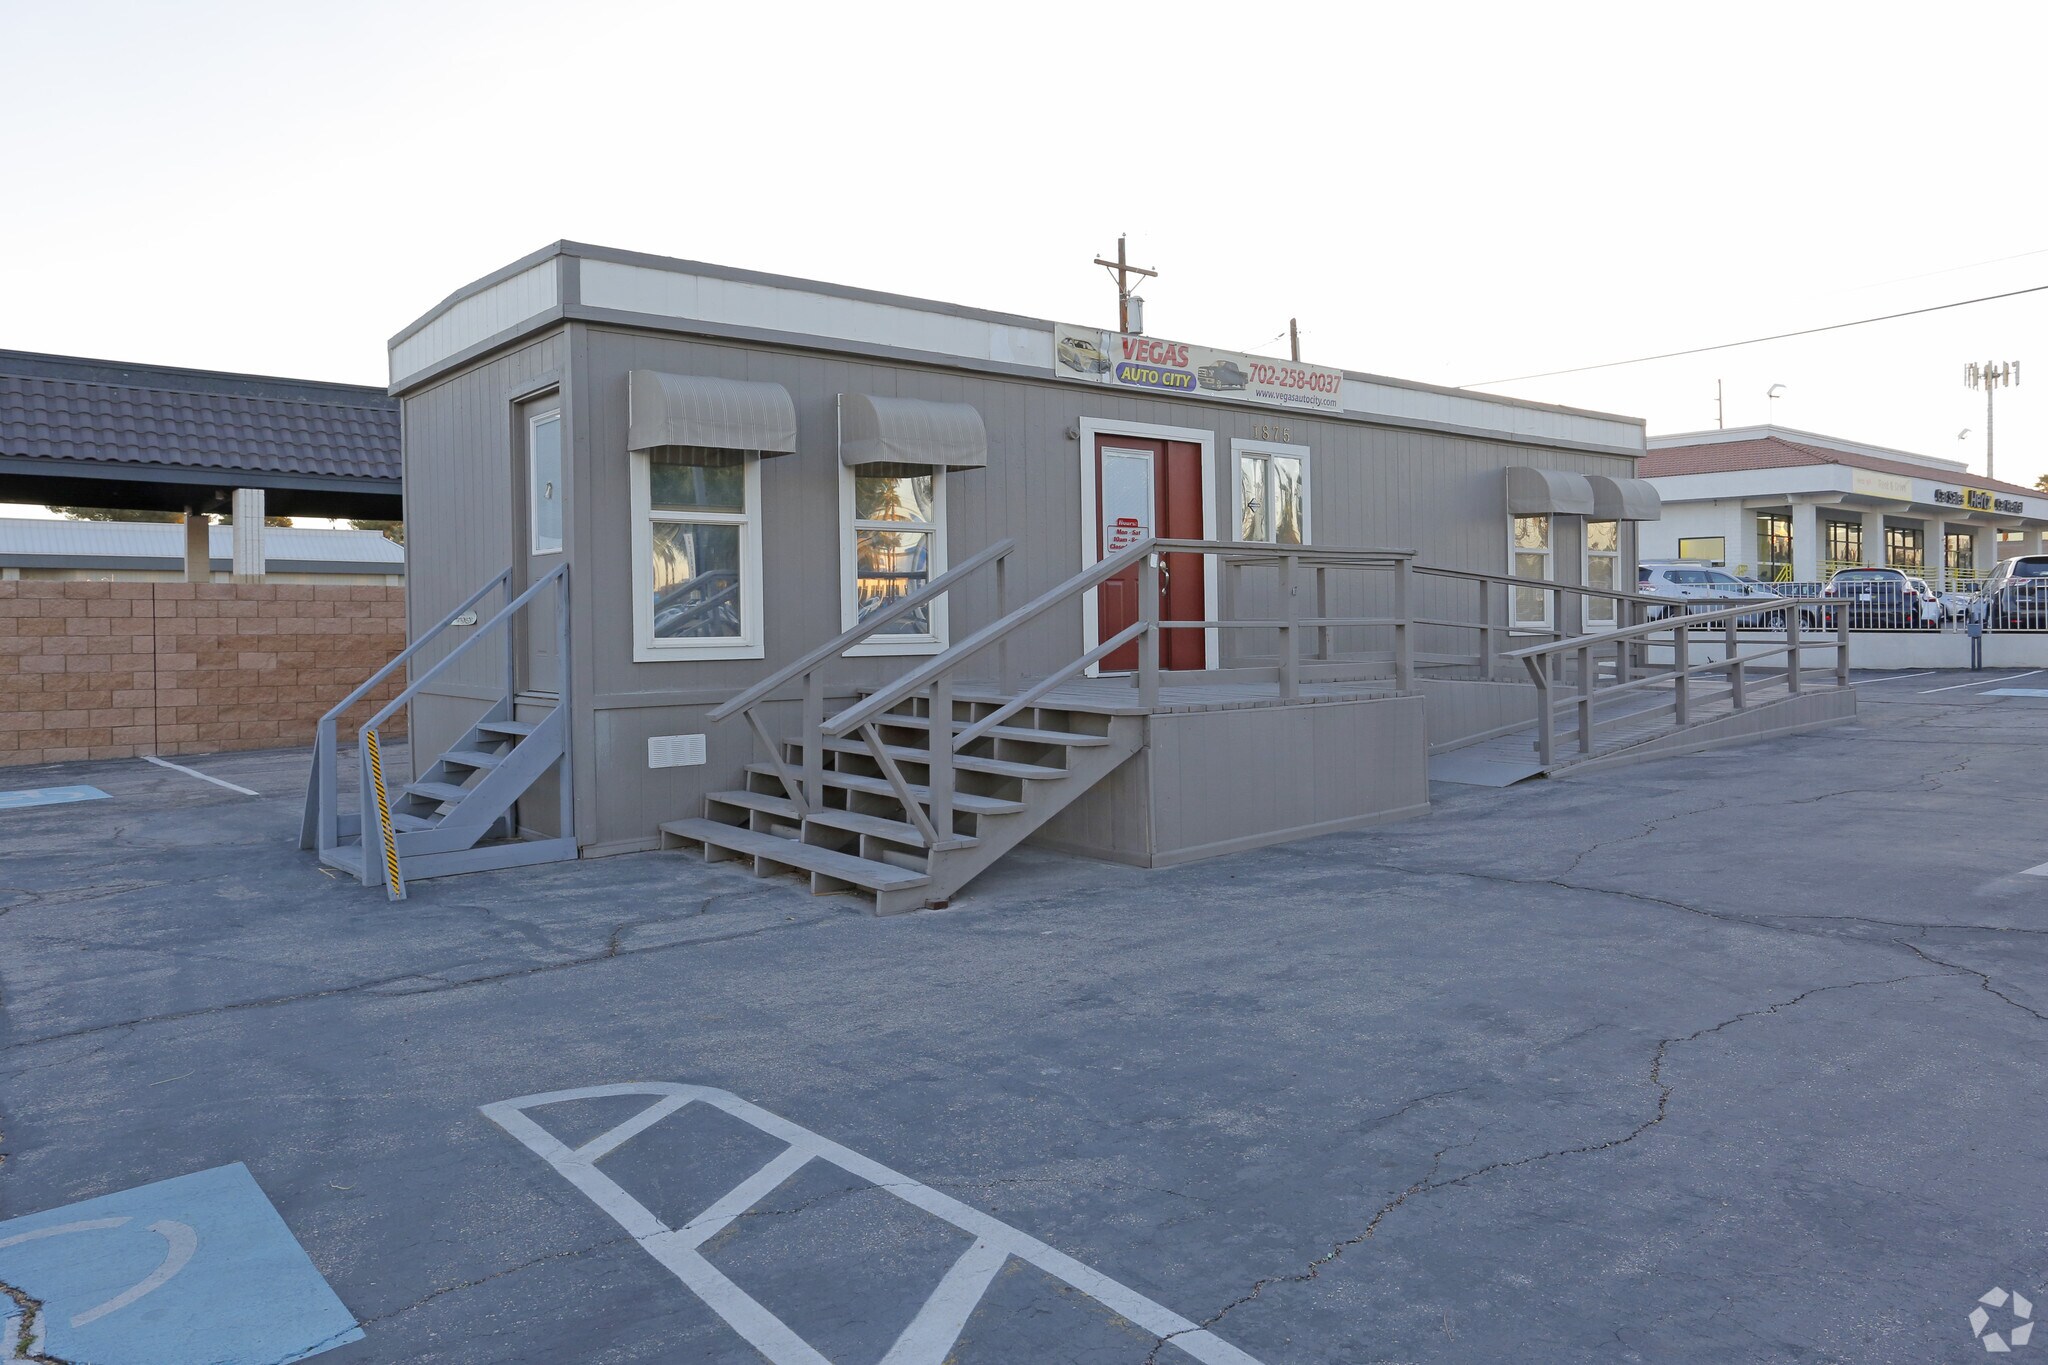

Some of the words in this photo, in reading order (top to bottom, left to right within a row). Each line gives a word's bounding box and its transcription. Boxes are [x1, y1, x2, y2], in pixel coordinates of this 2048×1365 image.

[1121, 337, 1189, 368] VEGAS
[1121, 367, 1159, 384] AUTO
[1162, 372, 1191, 388] CITY
[1249, 363, 1341, 394] 702-258-0037
[1255, 389, 1337, 407] www.vegasautocity.com
[1253, 424, 1290, 443] 1875
[1967, 490, 1992, 510] Hertz
